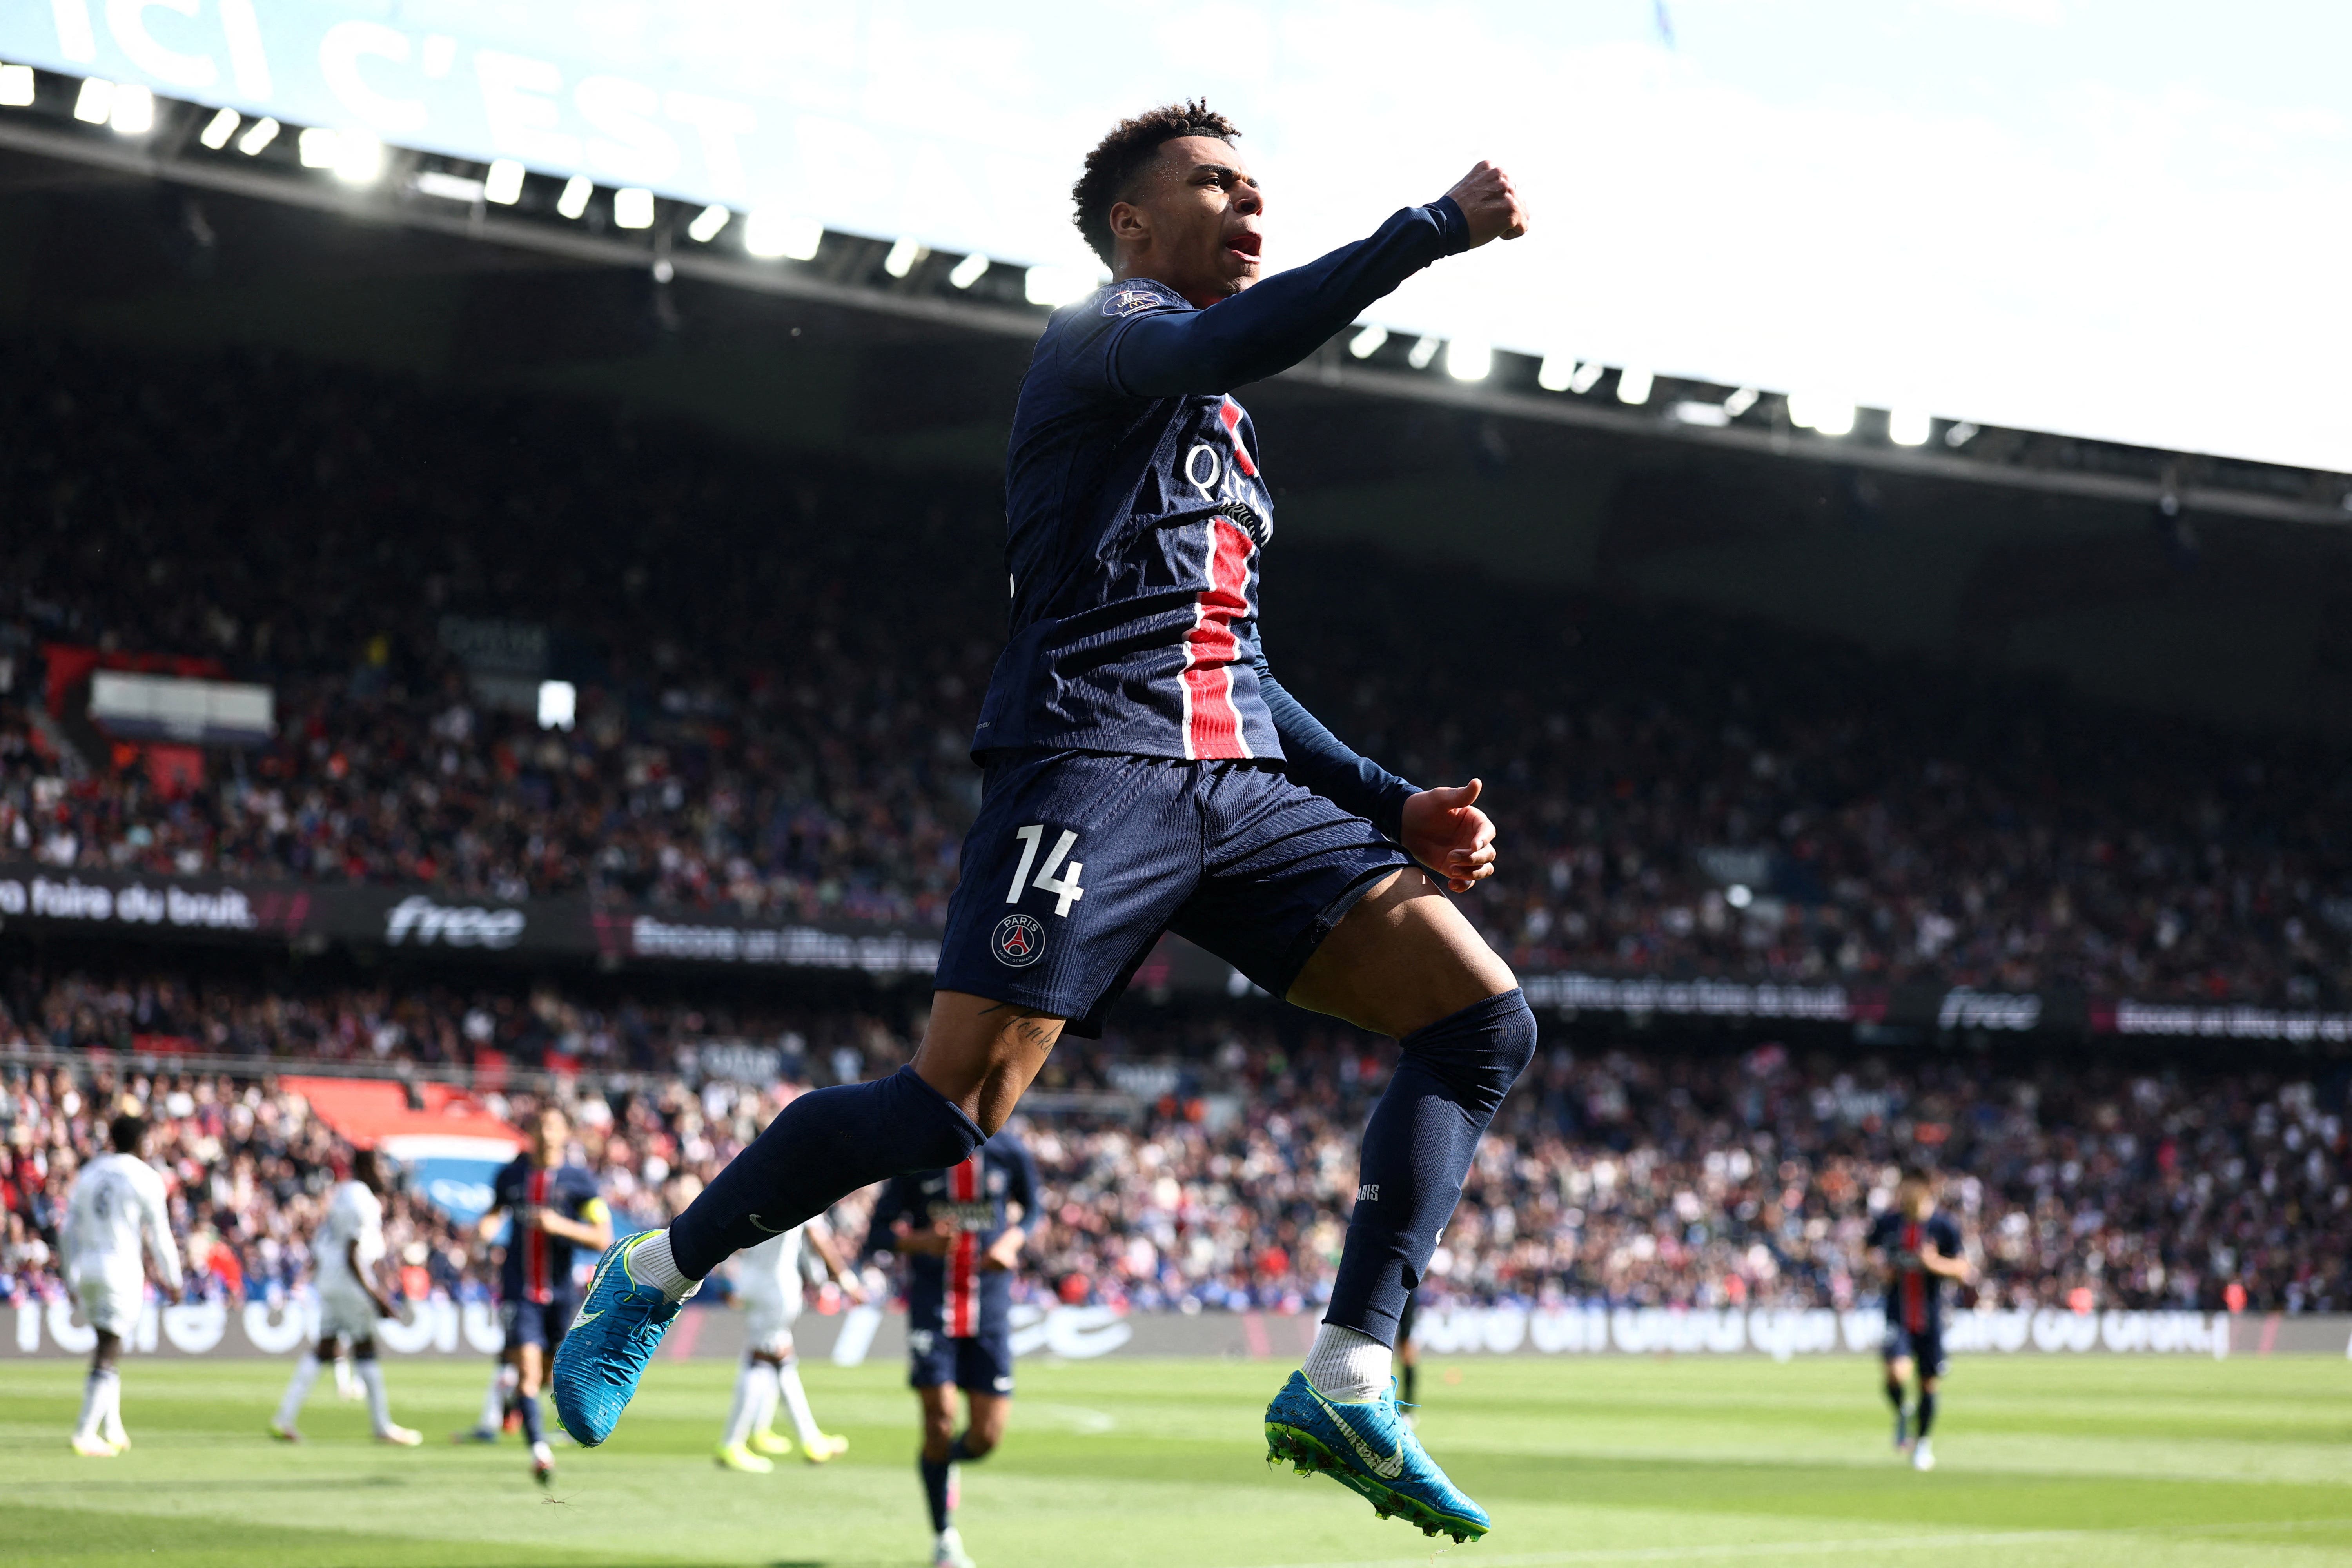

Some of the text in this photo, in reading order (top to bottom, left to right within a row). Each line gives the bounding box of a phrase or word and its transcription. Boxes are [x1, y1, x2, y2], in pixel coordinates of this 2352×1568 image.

[1124, 304, 1145, 314] CHAMPION
[1006, 824, 1084, 918] 14
[31, 876, 113, 920] faire
[117, 883, 164, 924] du
[385, 895, 526, 948] free
[1004, 916, 1038, 932] PARIS
[998, 949, 1009, 960] SAINT
[1356, 1184, 1379, 1202] ARIS
